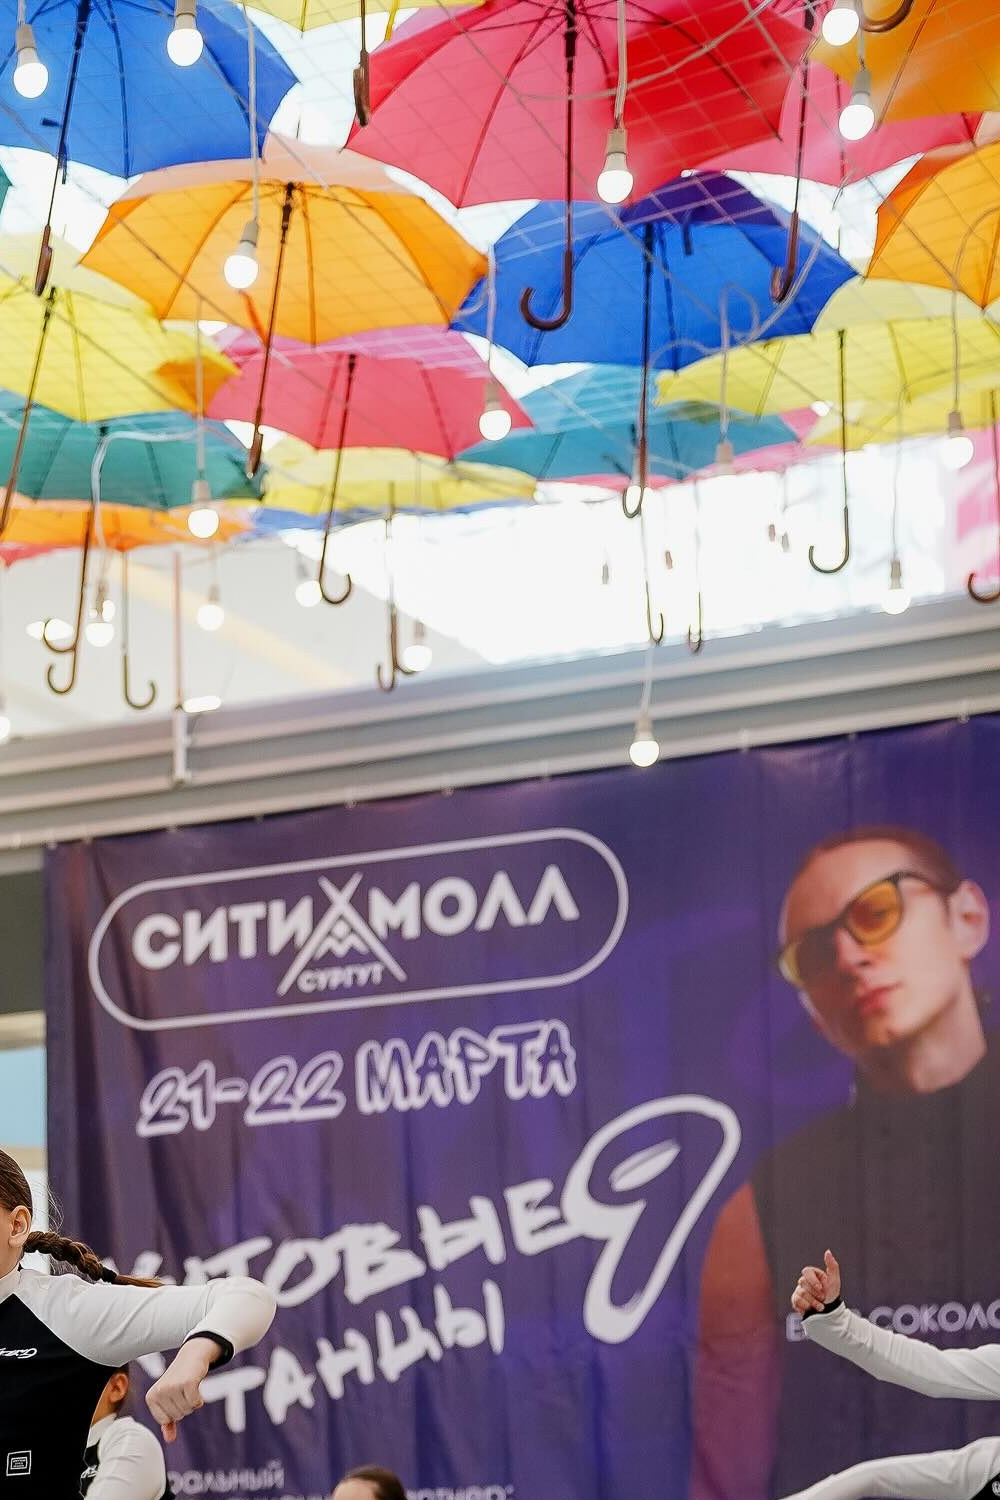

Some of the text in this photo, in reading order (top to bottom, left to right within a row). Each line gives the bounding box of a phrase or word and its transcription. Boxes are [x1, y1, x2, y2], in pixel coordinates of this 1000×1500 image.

[297, 962, 385, 994] СУРГУТ
[136, 1018, 577, 1136] 21-22 МАРТА
